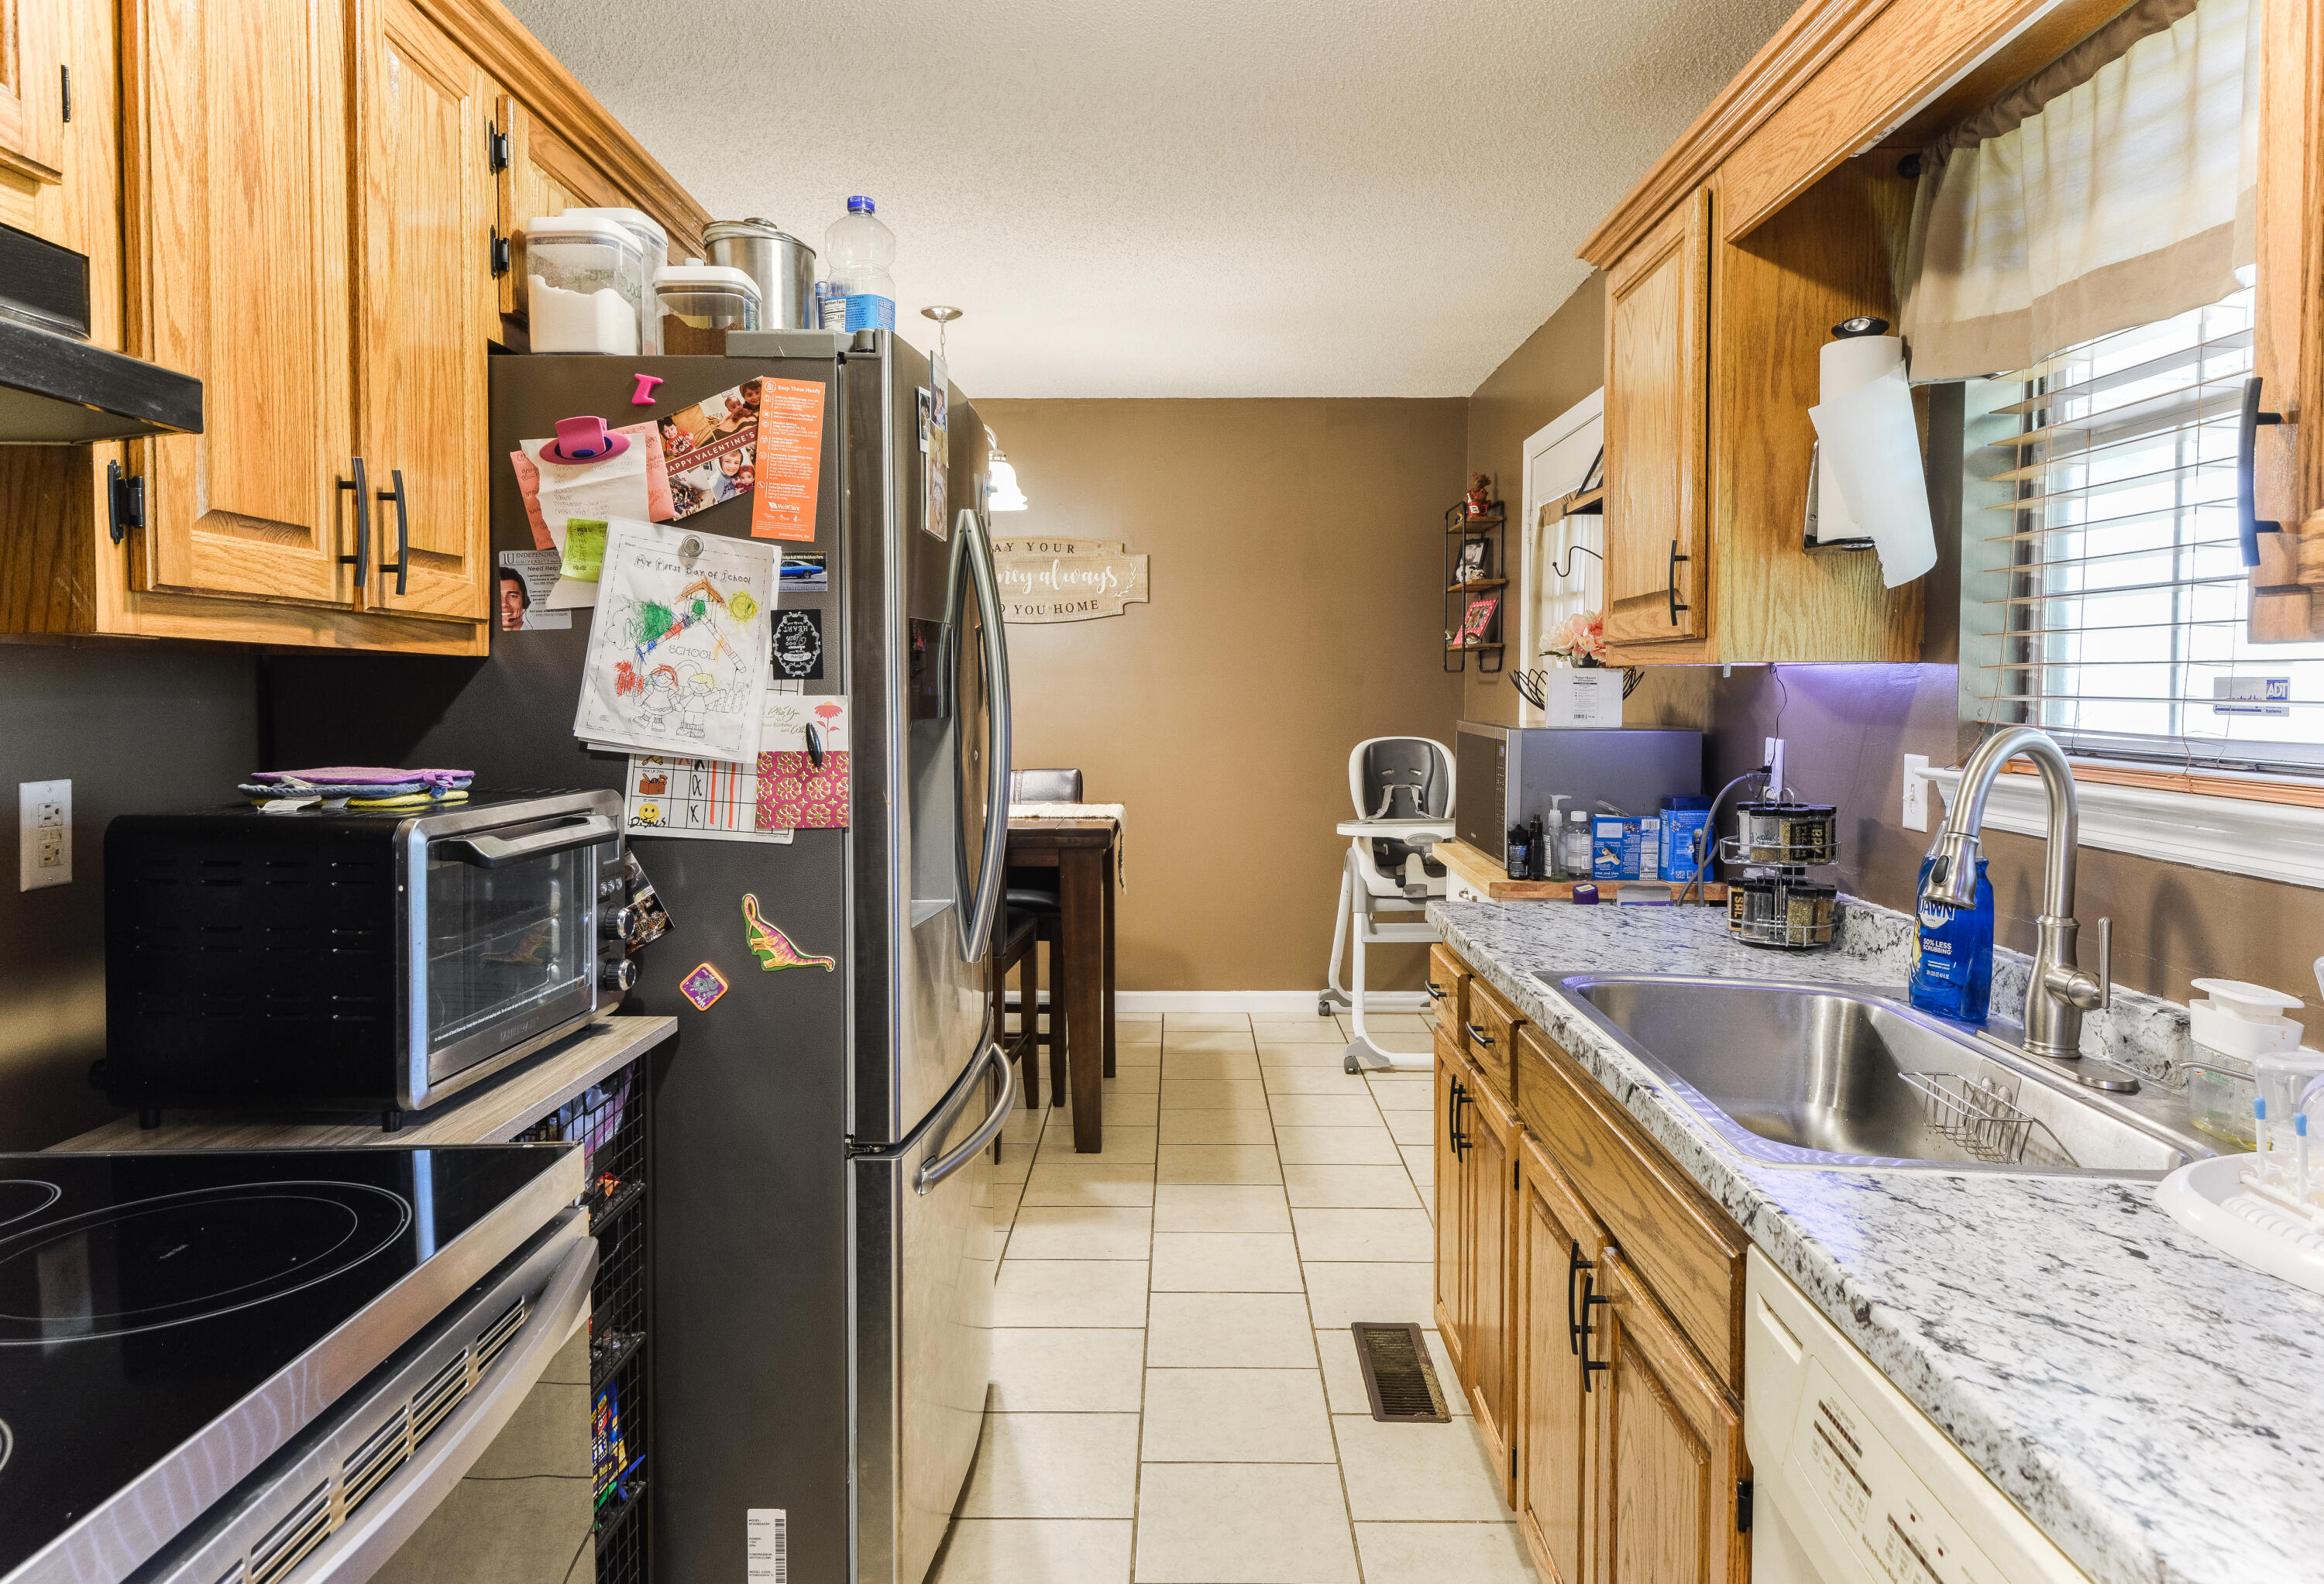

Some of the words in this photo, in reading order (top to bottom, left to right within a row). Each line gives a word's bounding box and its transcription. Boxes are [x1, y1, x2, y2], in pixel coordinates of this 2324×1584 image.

[806, 387, 821, 395] Handy
[667, 457, 692, 473] APPY
[695, 431, 755, 461] VALENTINE'S
[992, 542, 1014, 552] AY
[1026, 542, 1075, 554] YOUR
[503, 553, 514, 564] IU
[708, 571, 718, 579] of
[1040, 558, 1119, 594] always
[1013, 604, 1046, 615] YOU
[1054, 600, 1098, 614] HOME
[669, 644, 715, 660] SCHOOL
[2267, 682, 2288, 698] ADT
[1918, 895, 1954, 921] DAWN
[1923, 938, 1934, 947] 50%
[1935, 940, 1951, 950] LESS
[1923, 944, 1952, 955] SCRUBBING
